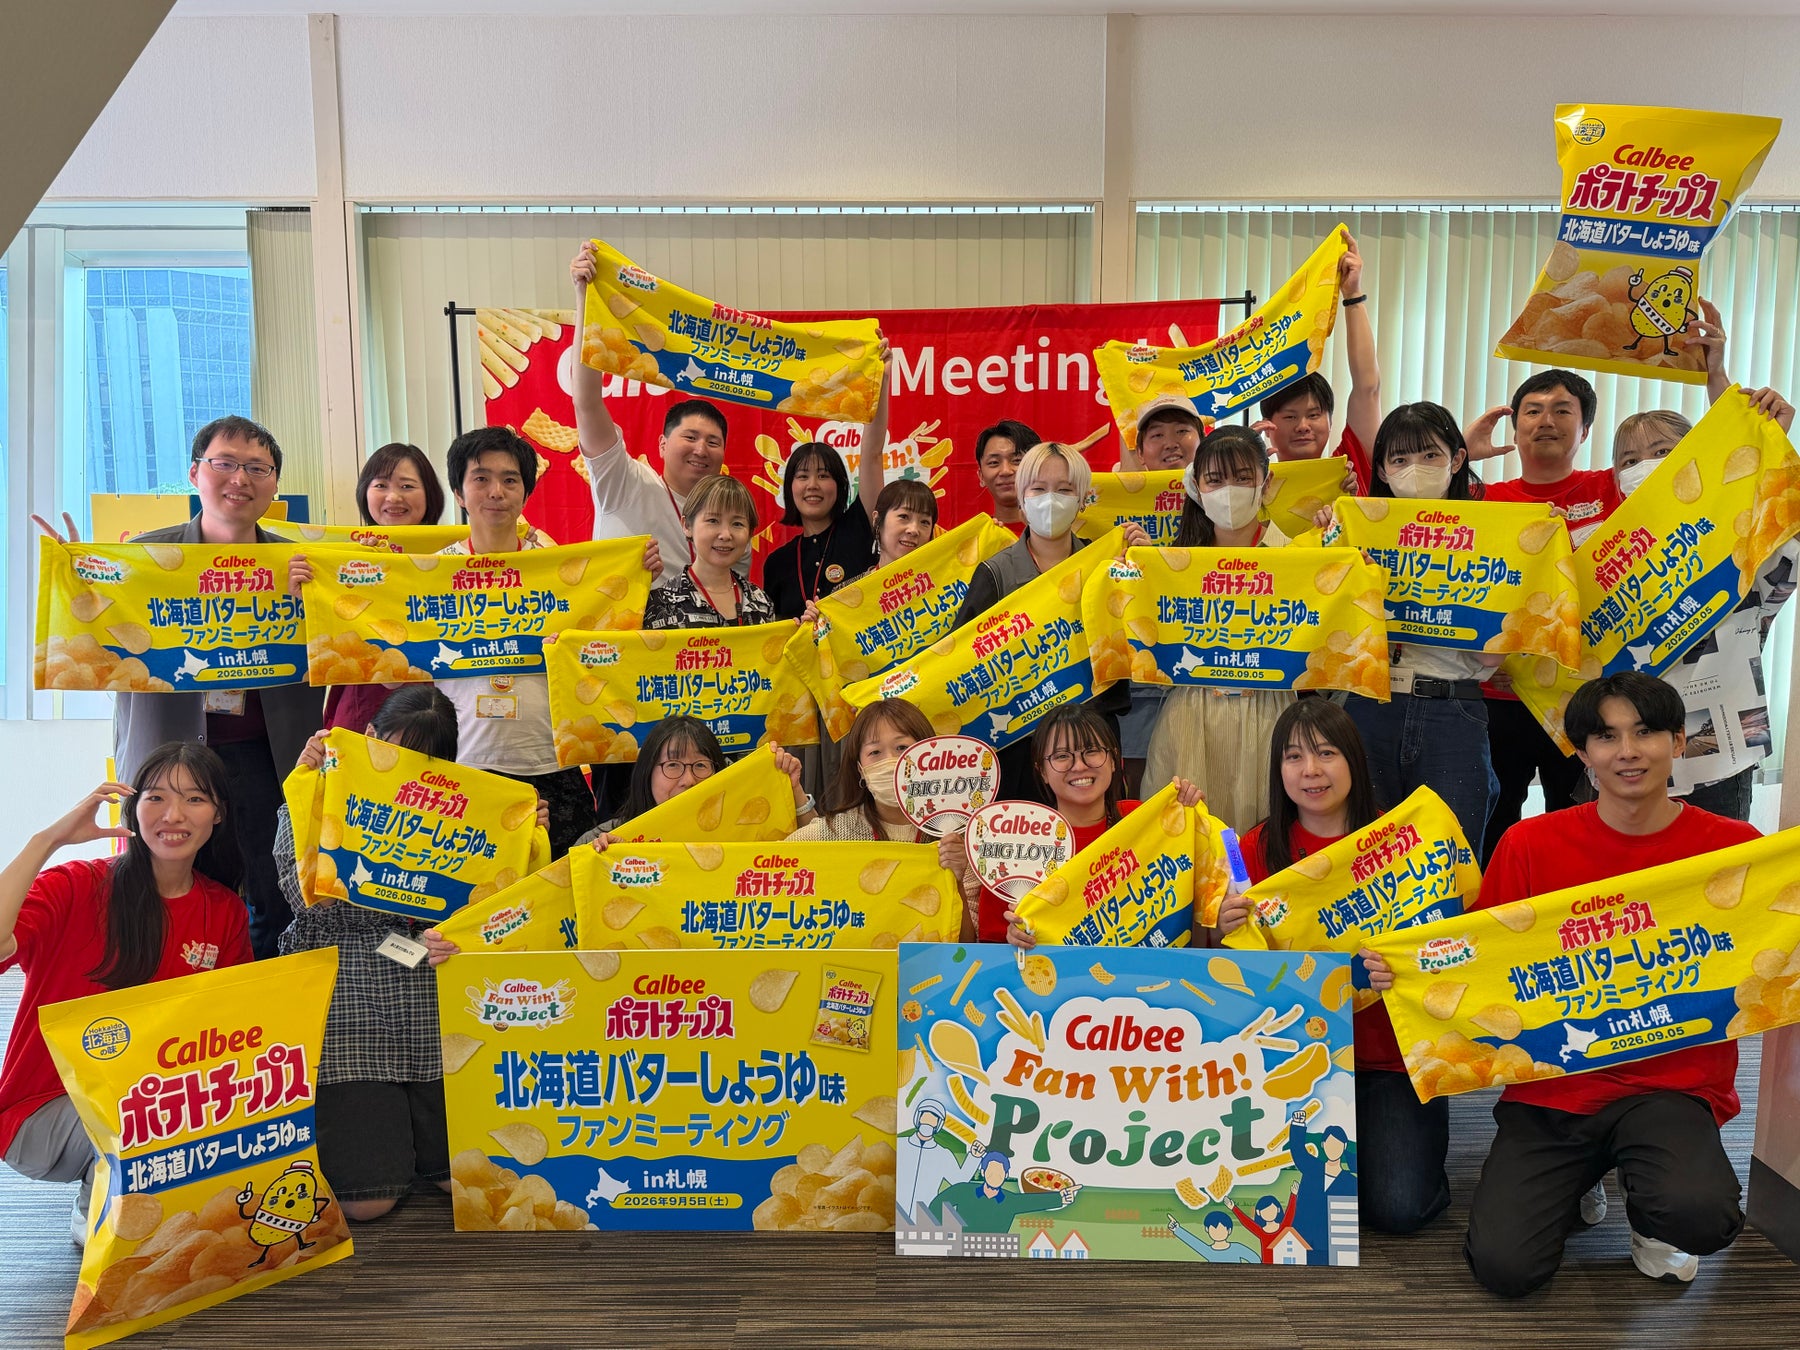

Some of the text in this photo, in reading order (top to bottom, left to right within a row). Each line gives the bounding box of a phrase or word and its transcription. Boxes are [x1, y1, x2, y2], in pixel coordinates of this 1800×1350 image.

[1613, 144, 1695, 171] Calbee
[1568, 164, 1719, 221] ポテトチップス
[1562, 219, 1701, 254] 北海道バターしょうゆ味
[1639, 300, 1673, 333] POTATO
[668, 309, 806, 361] 北海道バターしょうゆ味
[1178, 310, 1303, 382] 北海道バターしょうゆ味
[691, 340, 782, 373] ファンミーティング
[1206, 332, 1288, 389] ファンミーティング
[714, 367, 754, 387] in札幌
[891, 336, 1147, 406] Meetin
[1237, 362, 1277, 392] in札幌
[709, 382, 756, 397] 2026.09.05
[1241, 374, 1284, 400] 2026.09.05
[823, 428, 861, 448] Calb
[1416, 511, 1460, 524] Calbee
[1398, 523, 1474, 551] ポテトチップス
[1592, 529, 1627, 562] Calbee
[213, 556, 256, 568] Calbee
[466, 557, 505, 569] Calbee
[1217, 558, 1258, 571] Calbee
[1359, 546, 1522, 587] 海道バターしょうゆ味
[1594, 526, 1658, 593] ポテトチップス
[199, 568, 274, 593] ポテトチップス
[452, 567, 522, 590] ポテトチップス
[882, 568, 914, 589] Calbee
[1202, 571, 1274, 595] ポテトチップス
[1387, 581, 1491, 604] ァンミーティング
[1581, 517, 1715, 647] 北海道バターしょうゆ味
[405, 590, 570, 623] 北海道バターしょうゆ味
[879, 572, 935, 615] ポテトチップス
[1615, 551, 1703, 642] ファンミーティング
[148, 595, 305, 627] 北海道バターしょうゆ
[854, 579, 970, 656] 北海道バターしょうゆ
[976, 609, 1010, 634] Calbee
[1157, 595, 1320, 626] 北海道バターしょうゆ味
[1405, 606, 1452, 624] in札幌
[1653, 595, 1701, 638] in札幌
[181, 622, 299, 646] ファンミーティング
[437, 615, 546, 638] ファンミーティング
[972, 612, 1035, 660] ポテトチップス
[1183, 626, 1293, 646] ファンミーティング
[1401, 624, 1456, 637] 2026.09.05
[1665, 606, 1712, 651] 2026.09.05
[472, 639, 519, 656] in札幌
[687, 636, 720, 647] Calbee
[219, 649, 269, 665] in札幌
[470, 656, 525, 667] 2026.09.05
[675, 647, 733, 671] ポテトチップス
[946, 617, 1085, 708] 北海道バターしょうゆ味
[1214, 652, 1260, 667] in札幌
[217, 667, 275, 678] 2026.09.05
[636, 670, 772, 703] 北海道バターしょうゆ味
[980, 645, 1071, 708] ファンミーティング
[1210, 669, 1264, 679] 2026.09.05
[662, 695, 752, 718] ファンミーティング
[1017, 680, 1058, 712] in札幌
[1021, 694, 1068, 724] 2026.09.05
[917, 750, 978, 771] Calbee
[420, 771, 460, 791] Calbee
[910, 776, 991, 797] BIG LOVE
[393, 780, 470, 819] ポテトチップス
[345, 794, 497, 860] 北海道バターしょうゆ味
[989, 814, 1052, 836] Calbee
[1357, 822, 1395, 852] Calbee
[360, 833, 467, 873] ファンミーティング
[753, 855, 799, 868] Calbee
[982, 842, 1065, 862] BIG LOVE
[1089, 846, 1120, 876] Calbee
[1350, 823, 1423, 884] ポテトチップス
[381, 869, 429, 893] in札幌
[612, 871, 660, 883] Project
[735, 868, 815, 897] ポテトチップス
[1083, 849, 1140, 910] ポテトチップス
[375, 887, 427, 905] 2026.09.05
[1571, 893, 1624, 915] Calbee
[681, 900, 865, 933] 北海道バターしょうゆ味
[1558, 900, 1657, 951] ポテトチップス
[1420, 947, 1472, 970] Project
[1508, 922, 1734, 1004] 北海道バターしょうゆ味
[488, 991, 556, 1005] Fan With!
[504, 983, 538, 993] Calbee
[633, 974, 705, 995] Calbee
[828, 986, 869, 1004] ポテトチップス
[839, 980, 862, 989] Calbee
[1555, 960, 1702, 1018] ファンミーティング
[483, 1002, 559, 1021] Project
[606, 996, 735, 1041] ポテトチップス
[1606, 1004, 1673, 1034] in札幌
[157, 1026, 263, 1070] Calbee
[1065, 1015, 1185, 1053] Calbee
[1610, 1026, 1685, 1051] 2026.09.05
[493, 1048, 847, 1110] 北海道バターしょうゆ味
[1003, 1049, 1253, 1103] Fan With!
[119, 1042, 313, 1151] ポテトチップス
[556, 1110, 791, 1148] ファンミーティング
[988, 1094, 1265, 1168] Project
[127, 1119, 311, 1193] 北海道バターしょうゆ味
[643, 1169, 708, 1190] in札幌
[258, 1212, 303, 1230] POTATO
